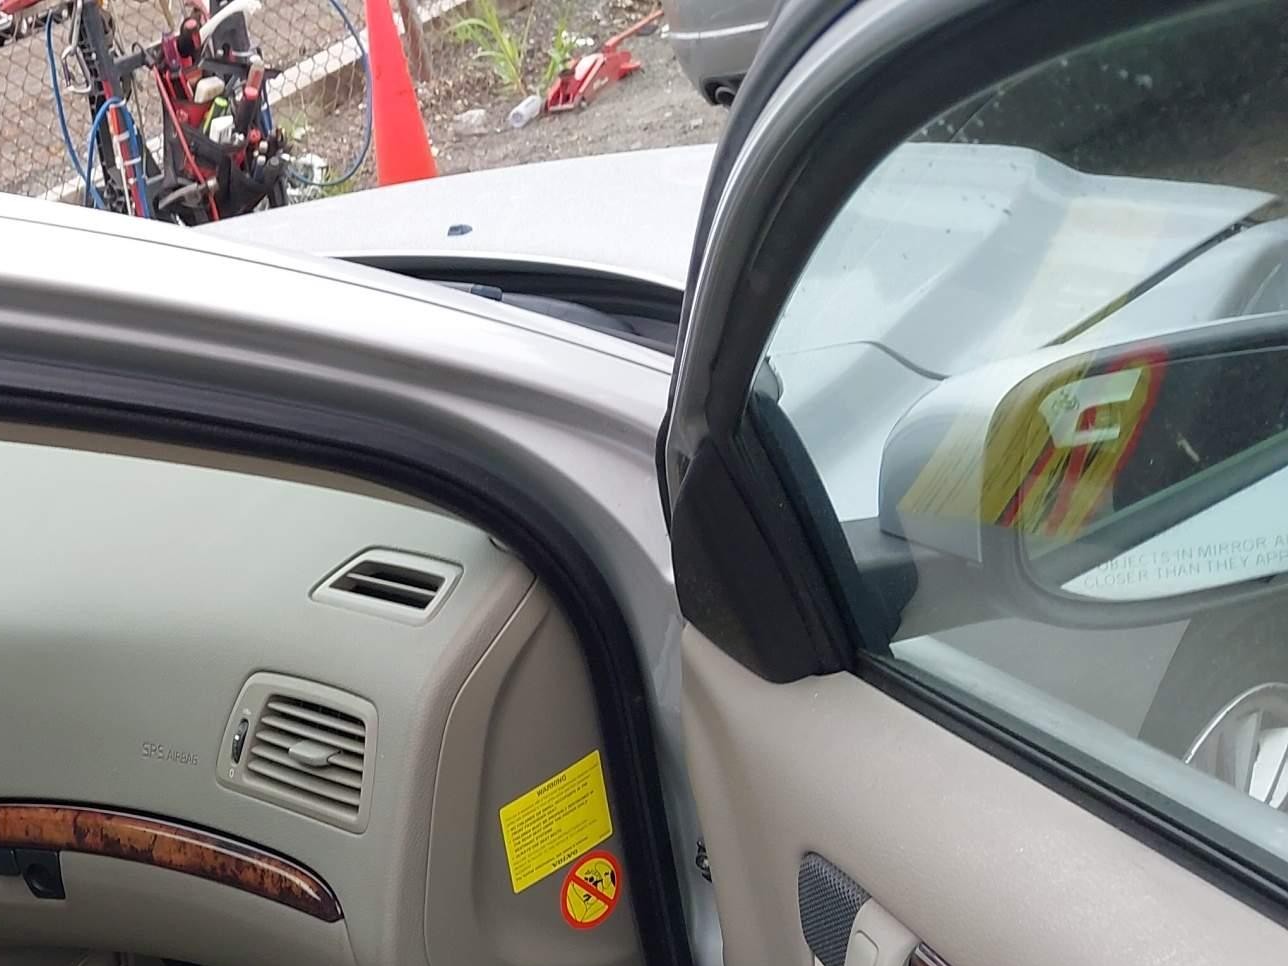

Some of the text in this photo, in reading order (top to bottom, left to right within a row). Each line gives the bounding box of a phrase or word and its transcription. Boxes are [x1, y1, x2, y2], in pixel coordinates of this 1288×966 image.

[1198, 538, 1267, 557] MIRROR
[1083, 569, 1149, 588] CLOSER
[1157, 563, 1201, 580] THAN
[1208, 554, 1249, 572] THEY
